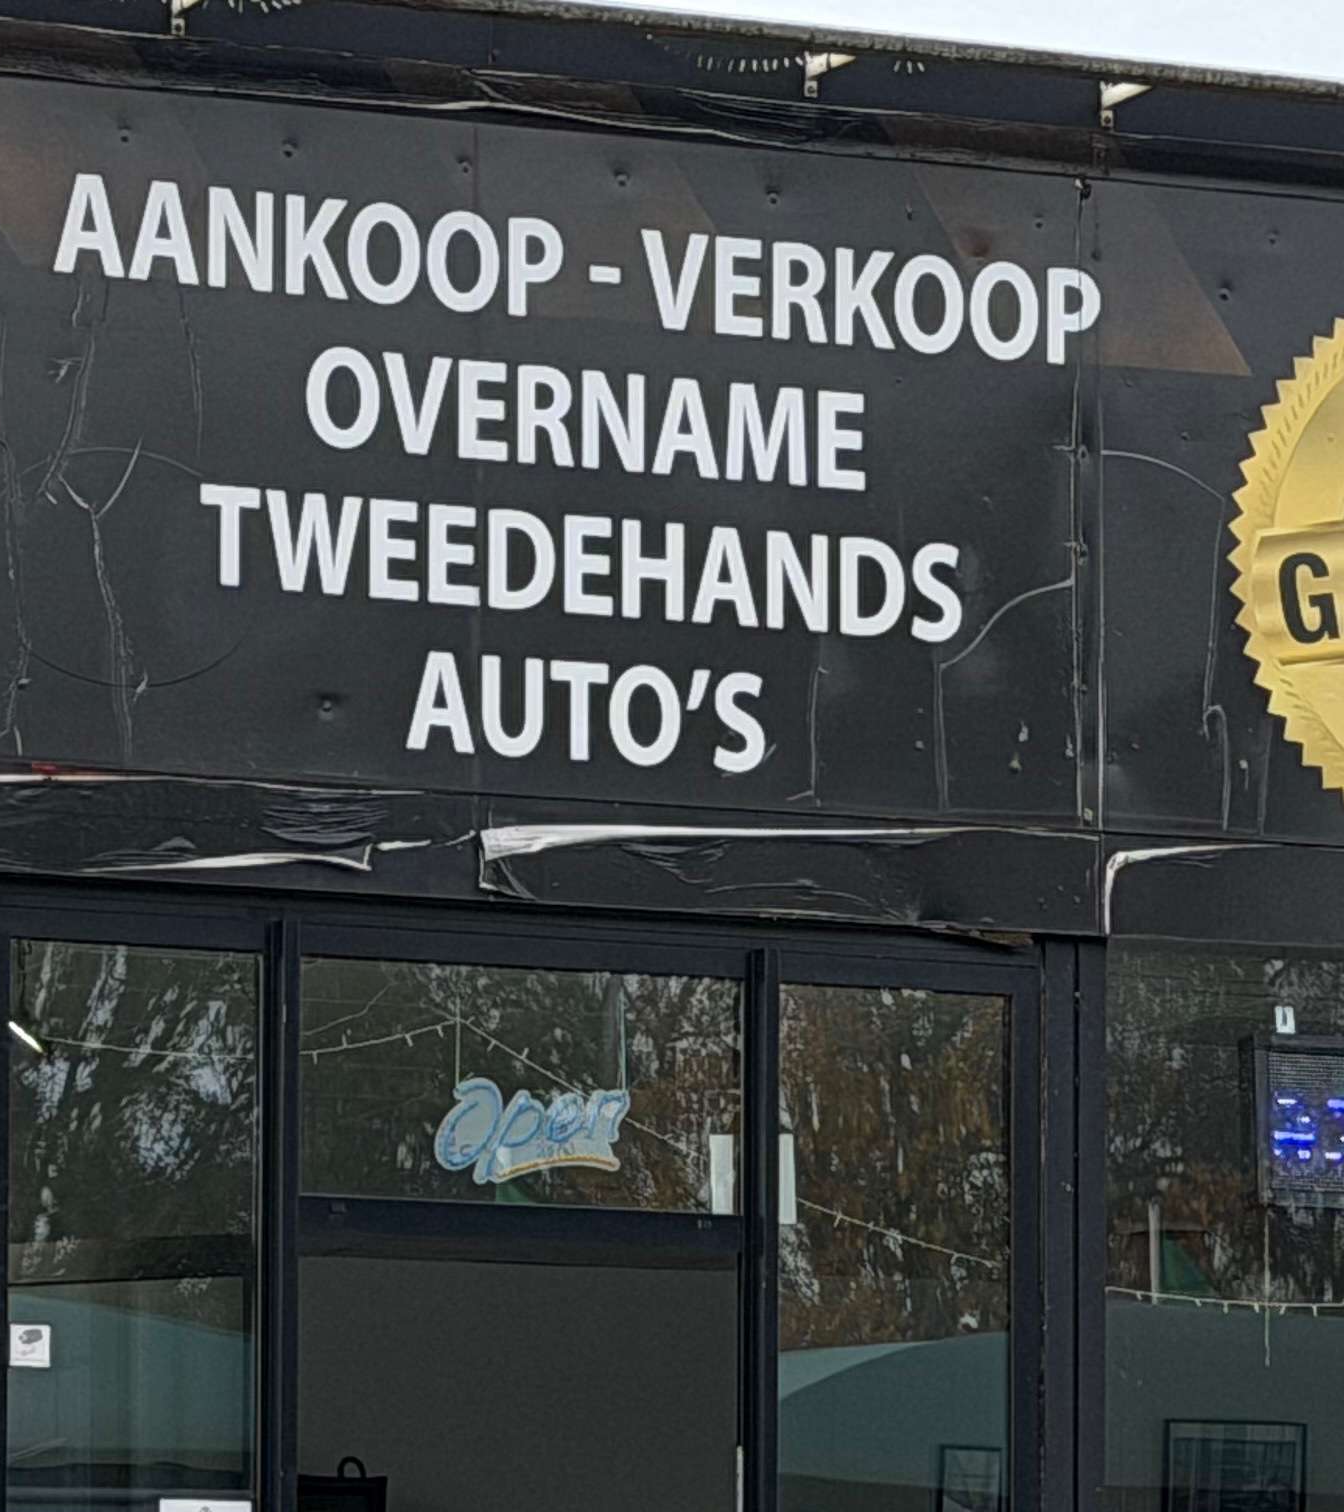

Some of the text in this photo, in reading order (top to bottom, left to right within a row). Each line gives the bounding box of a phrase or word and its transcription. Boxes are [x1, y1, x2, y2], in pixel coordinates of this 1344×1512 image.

[54, 172, 1102, 366] AANKOOP - VERKOOP
[305, 346, 867, 492] OVERNAME
[200, 483, 962, 644] TWEEDEHANDS
[405, 650, 767, 773] AUTO'S
[434, 1076, 632, 1185] Open
